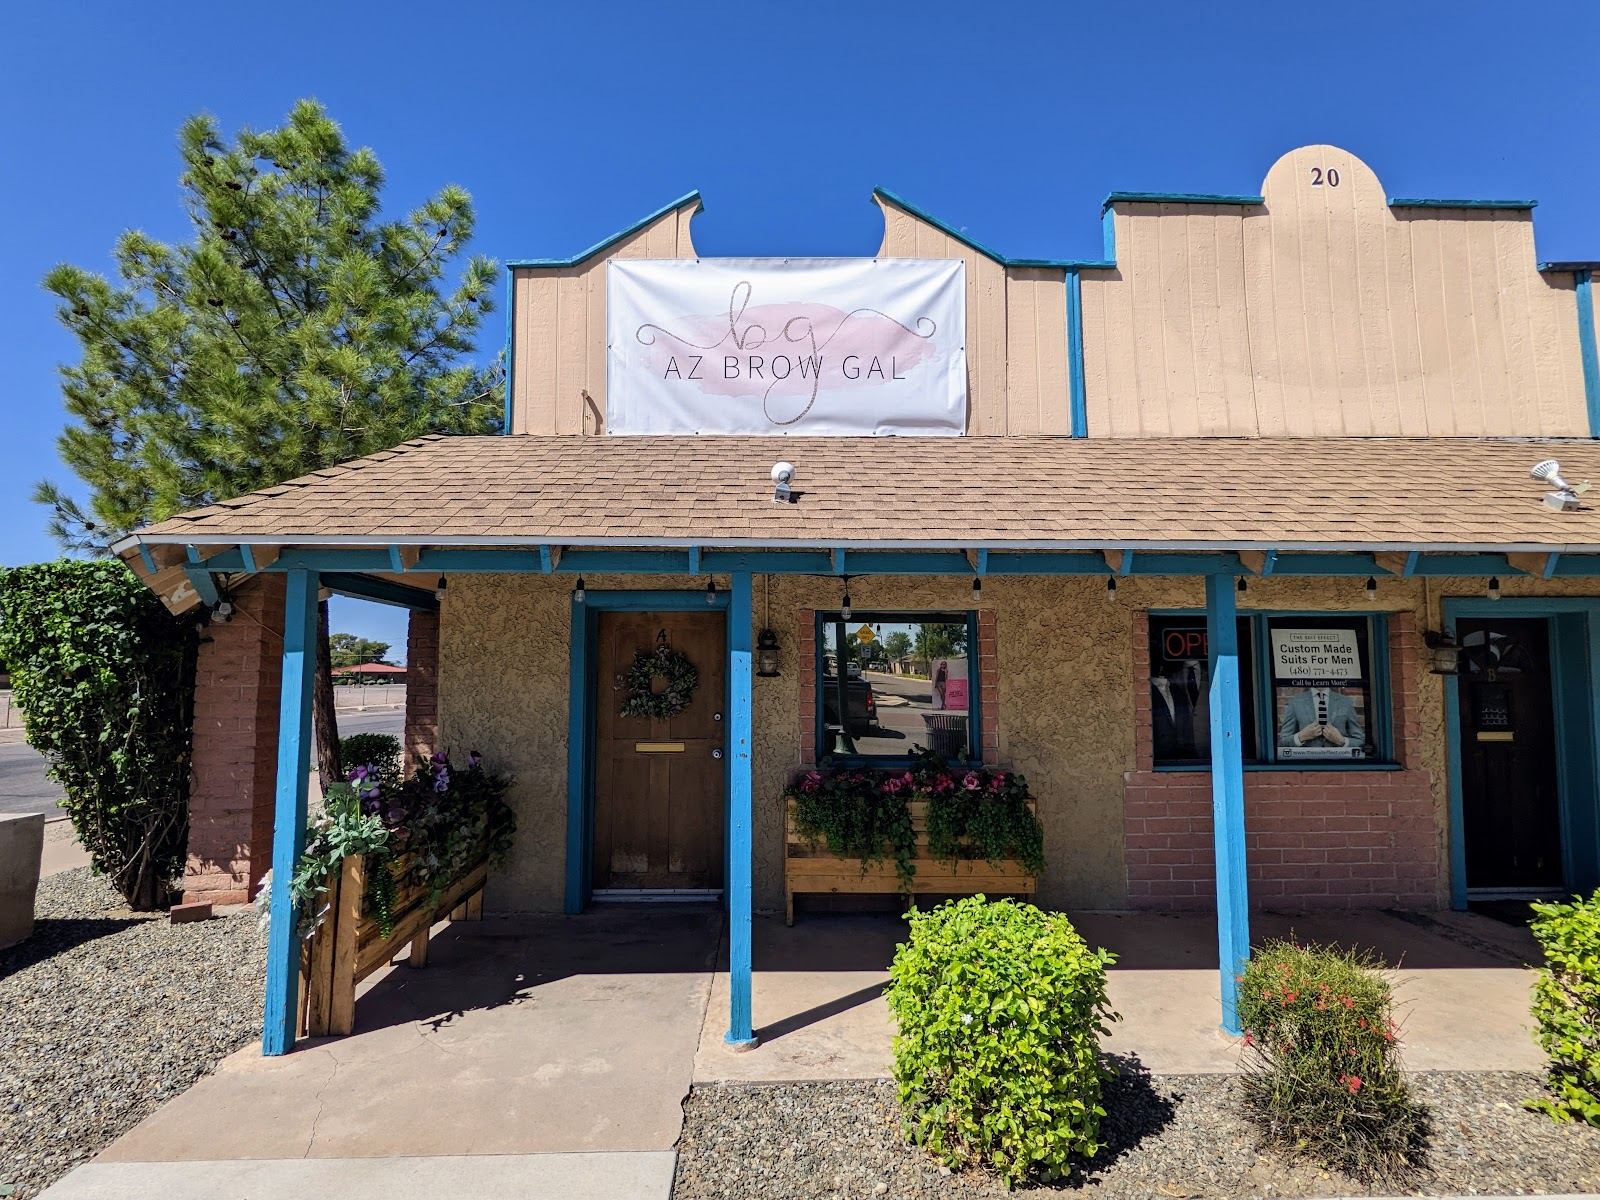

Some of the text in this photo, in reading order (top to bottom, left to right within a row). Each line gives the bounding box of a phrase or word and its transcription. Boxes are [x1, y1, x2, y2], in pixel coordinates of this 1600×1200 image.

[1310, 167, 1340, 187] 20
[664, 355, 906, 380] AZ BROW GAL
[1280, 644, 1352, 653] Custom Made
[1281, 655, 1354, 664] Suits For Men
[1289, 666, 1311, 676] (480)
